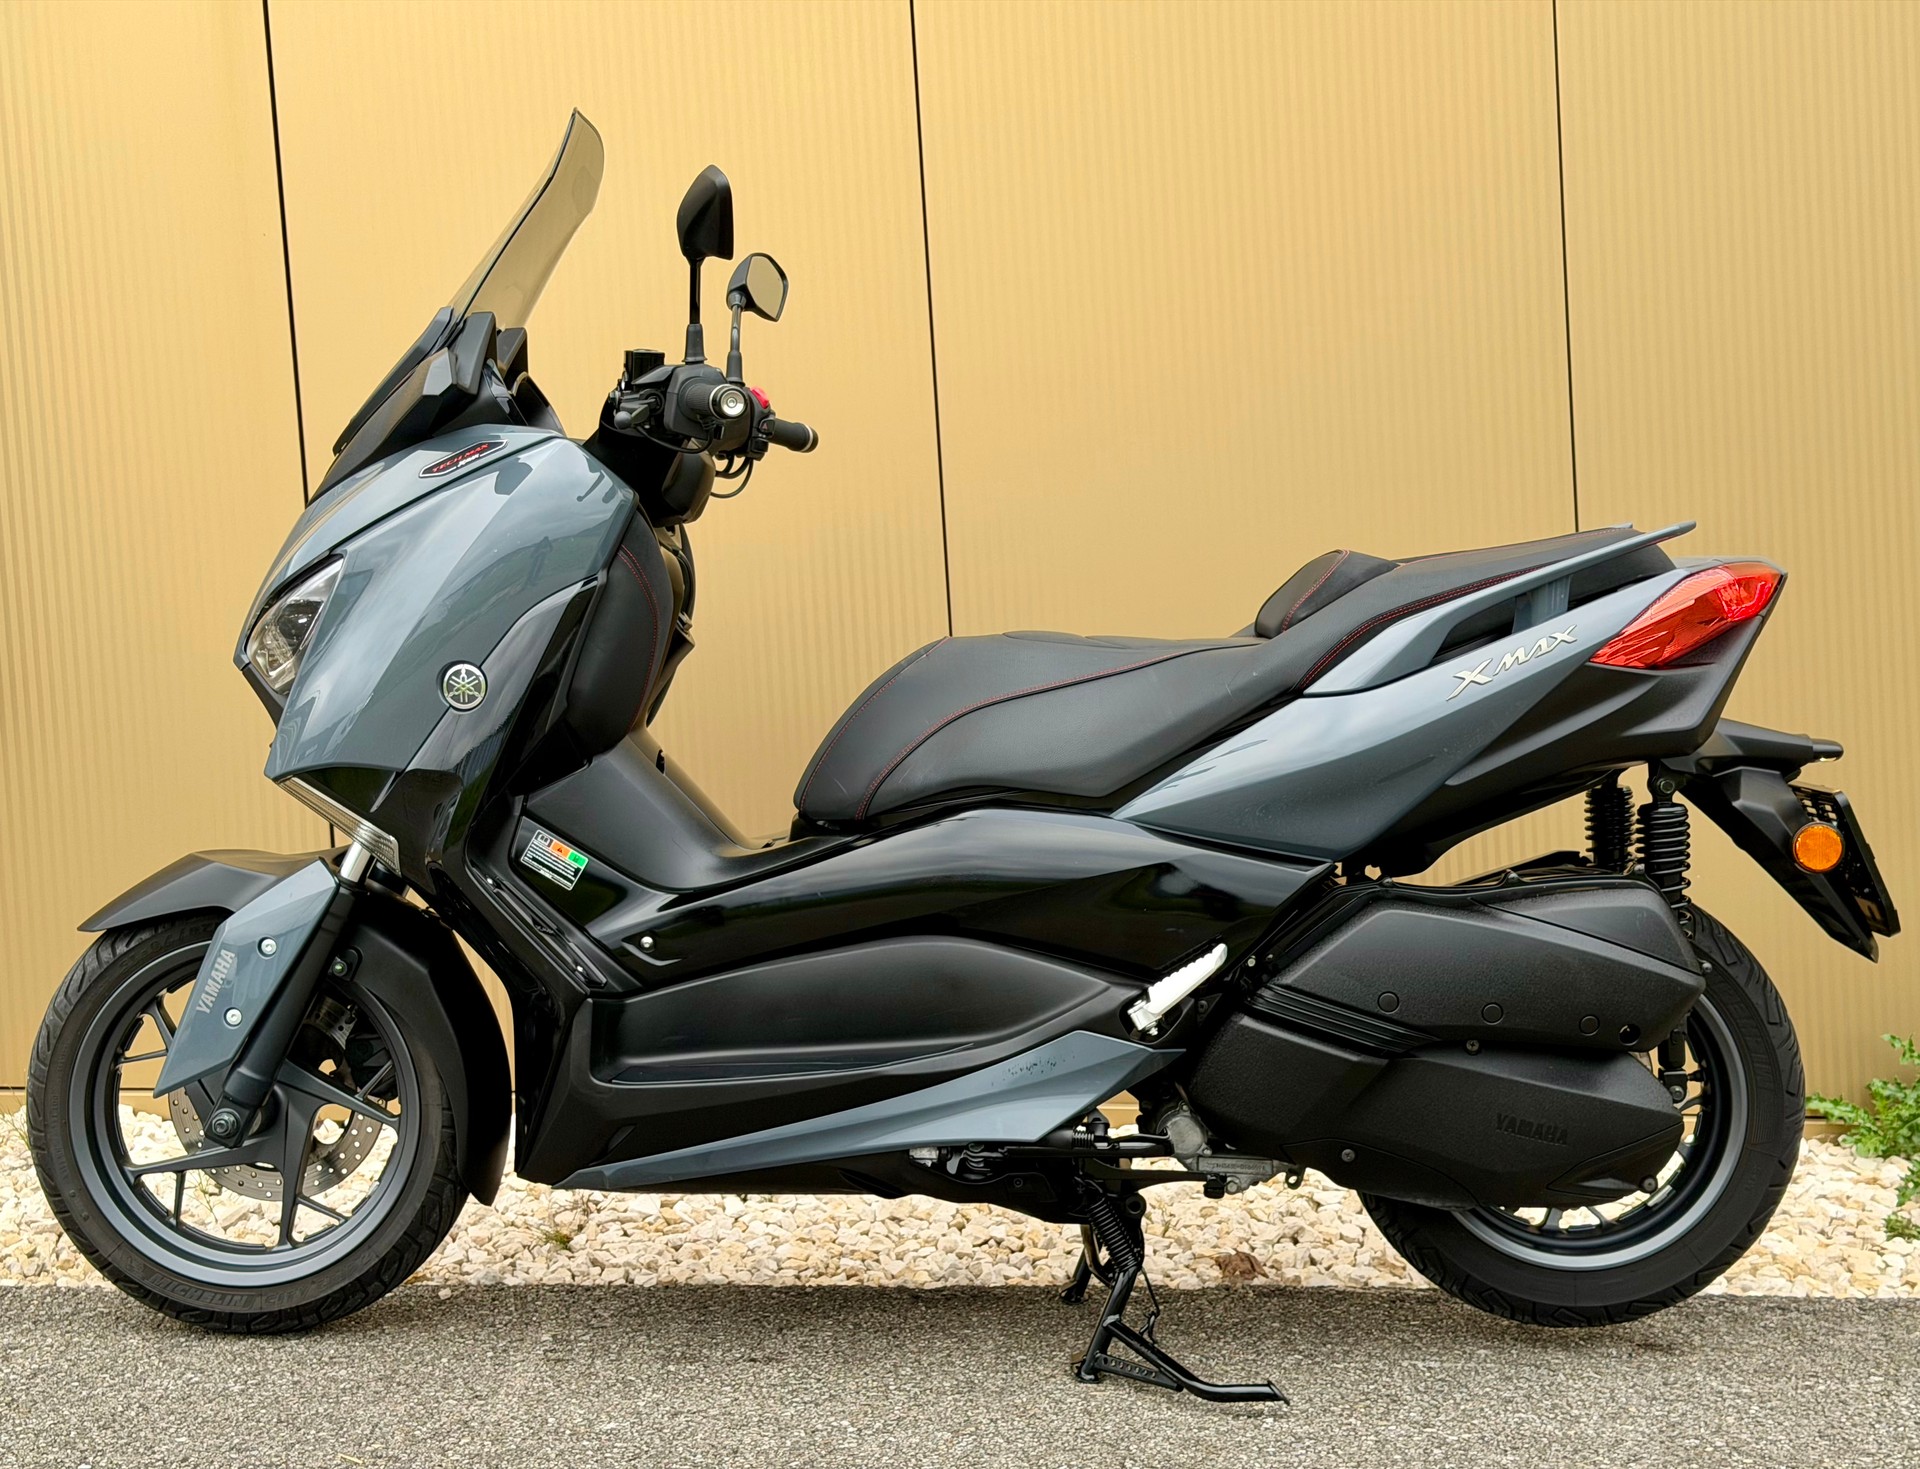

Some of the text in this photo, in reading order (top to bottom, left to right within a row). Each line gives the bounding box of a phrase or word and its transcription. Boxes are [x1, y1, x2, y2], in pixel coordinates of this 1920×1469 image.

[1446, 624, 1578, 702] XMAX
[195, 949, 236, 1014] YAMAHA
[1496, 1113, 1568, 1147] YAMAHA
[149, 1272, 248, 1307] MICHELIN
